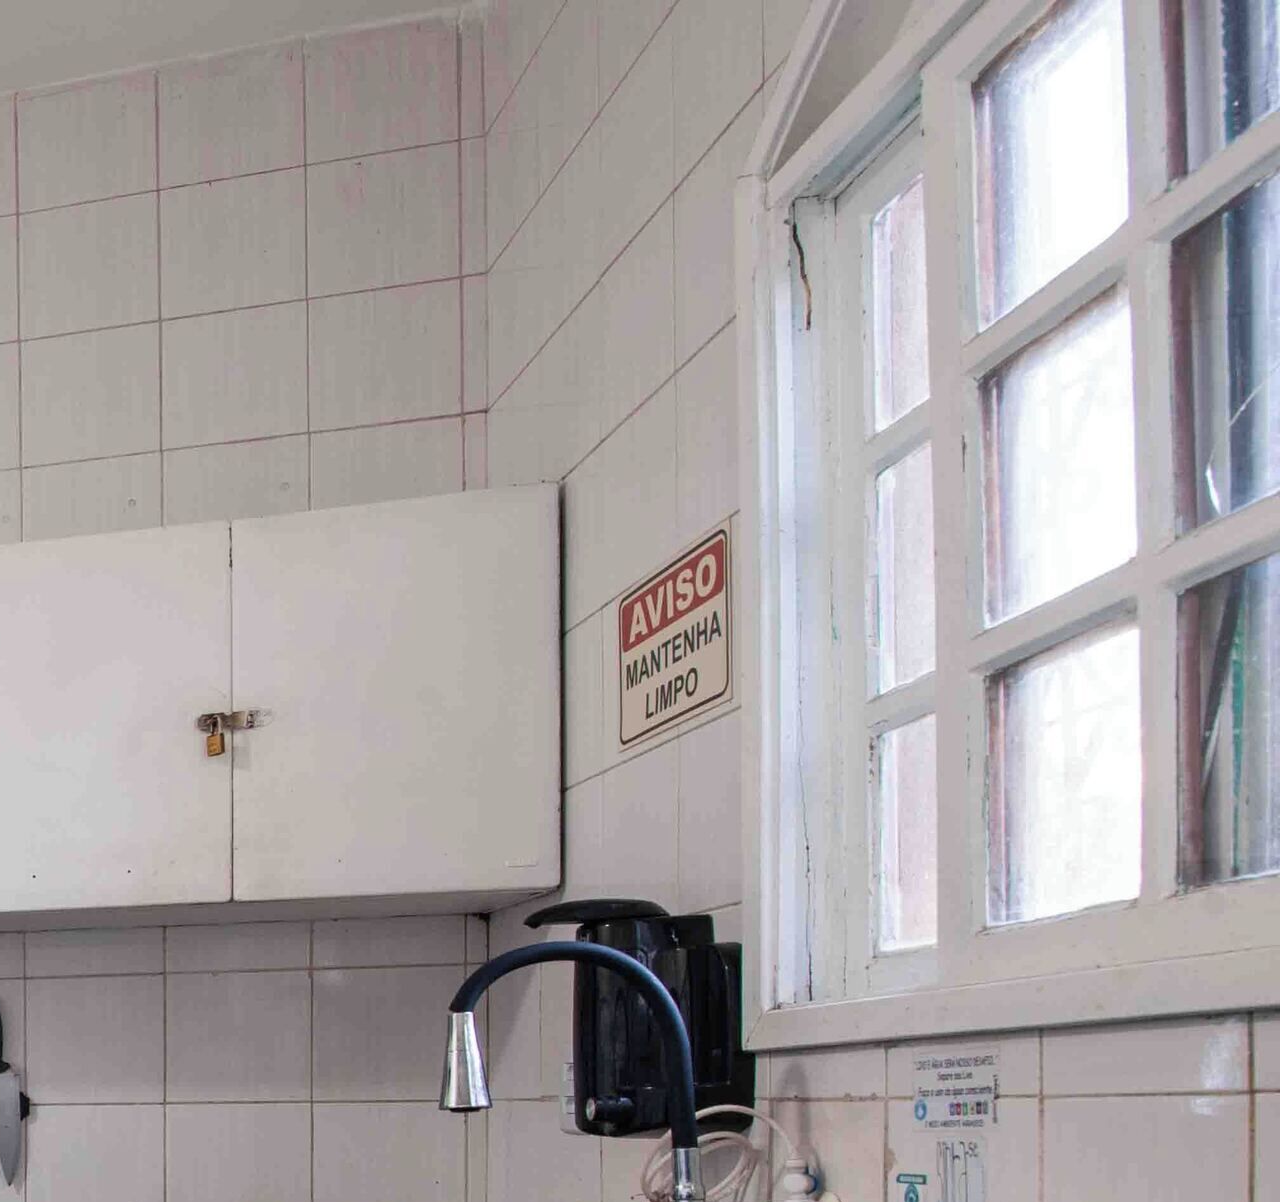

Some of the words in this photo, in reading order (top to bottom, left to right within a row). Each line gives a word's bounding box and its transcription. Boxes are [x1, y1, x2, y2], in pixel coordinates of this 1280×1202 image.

[629, 554, 717, 643] AVISO
[626, 610, 722, 690] MANTENHA
[645, 667, 698, 719] LIMPO
